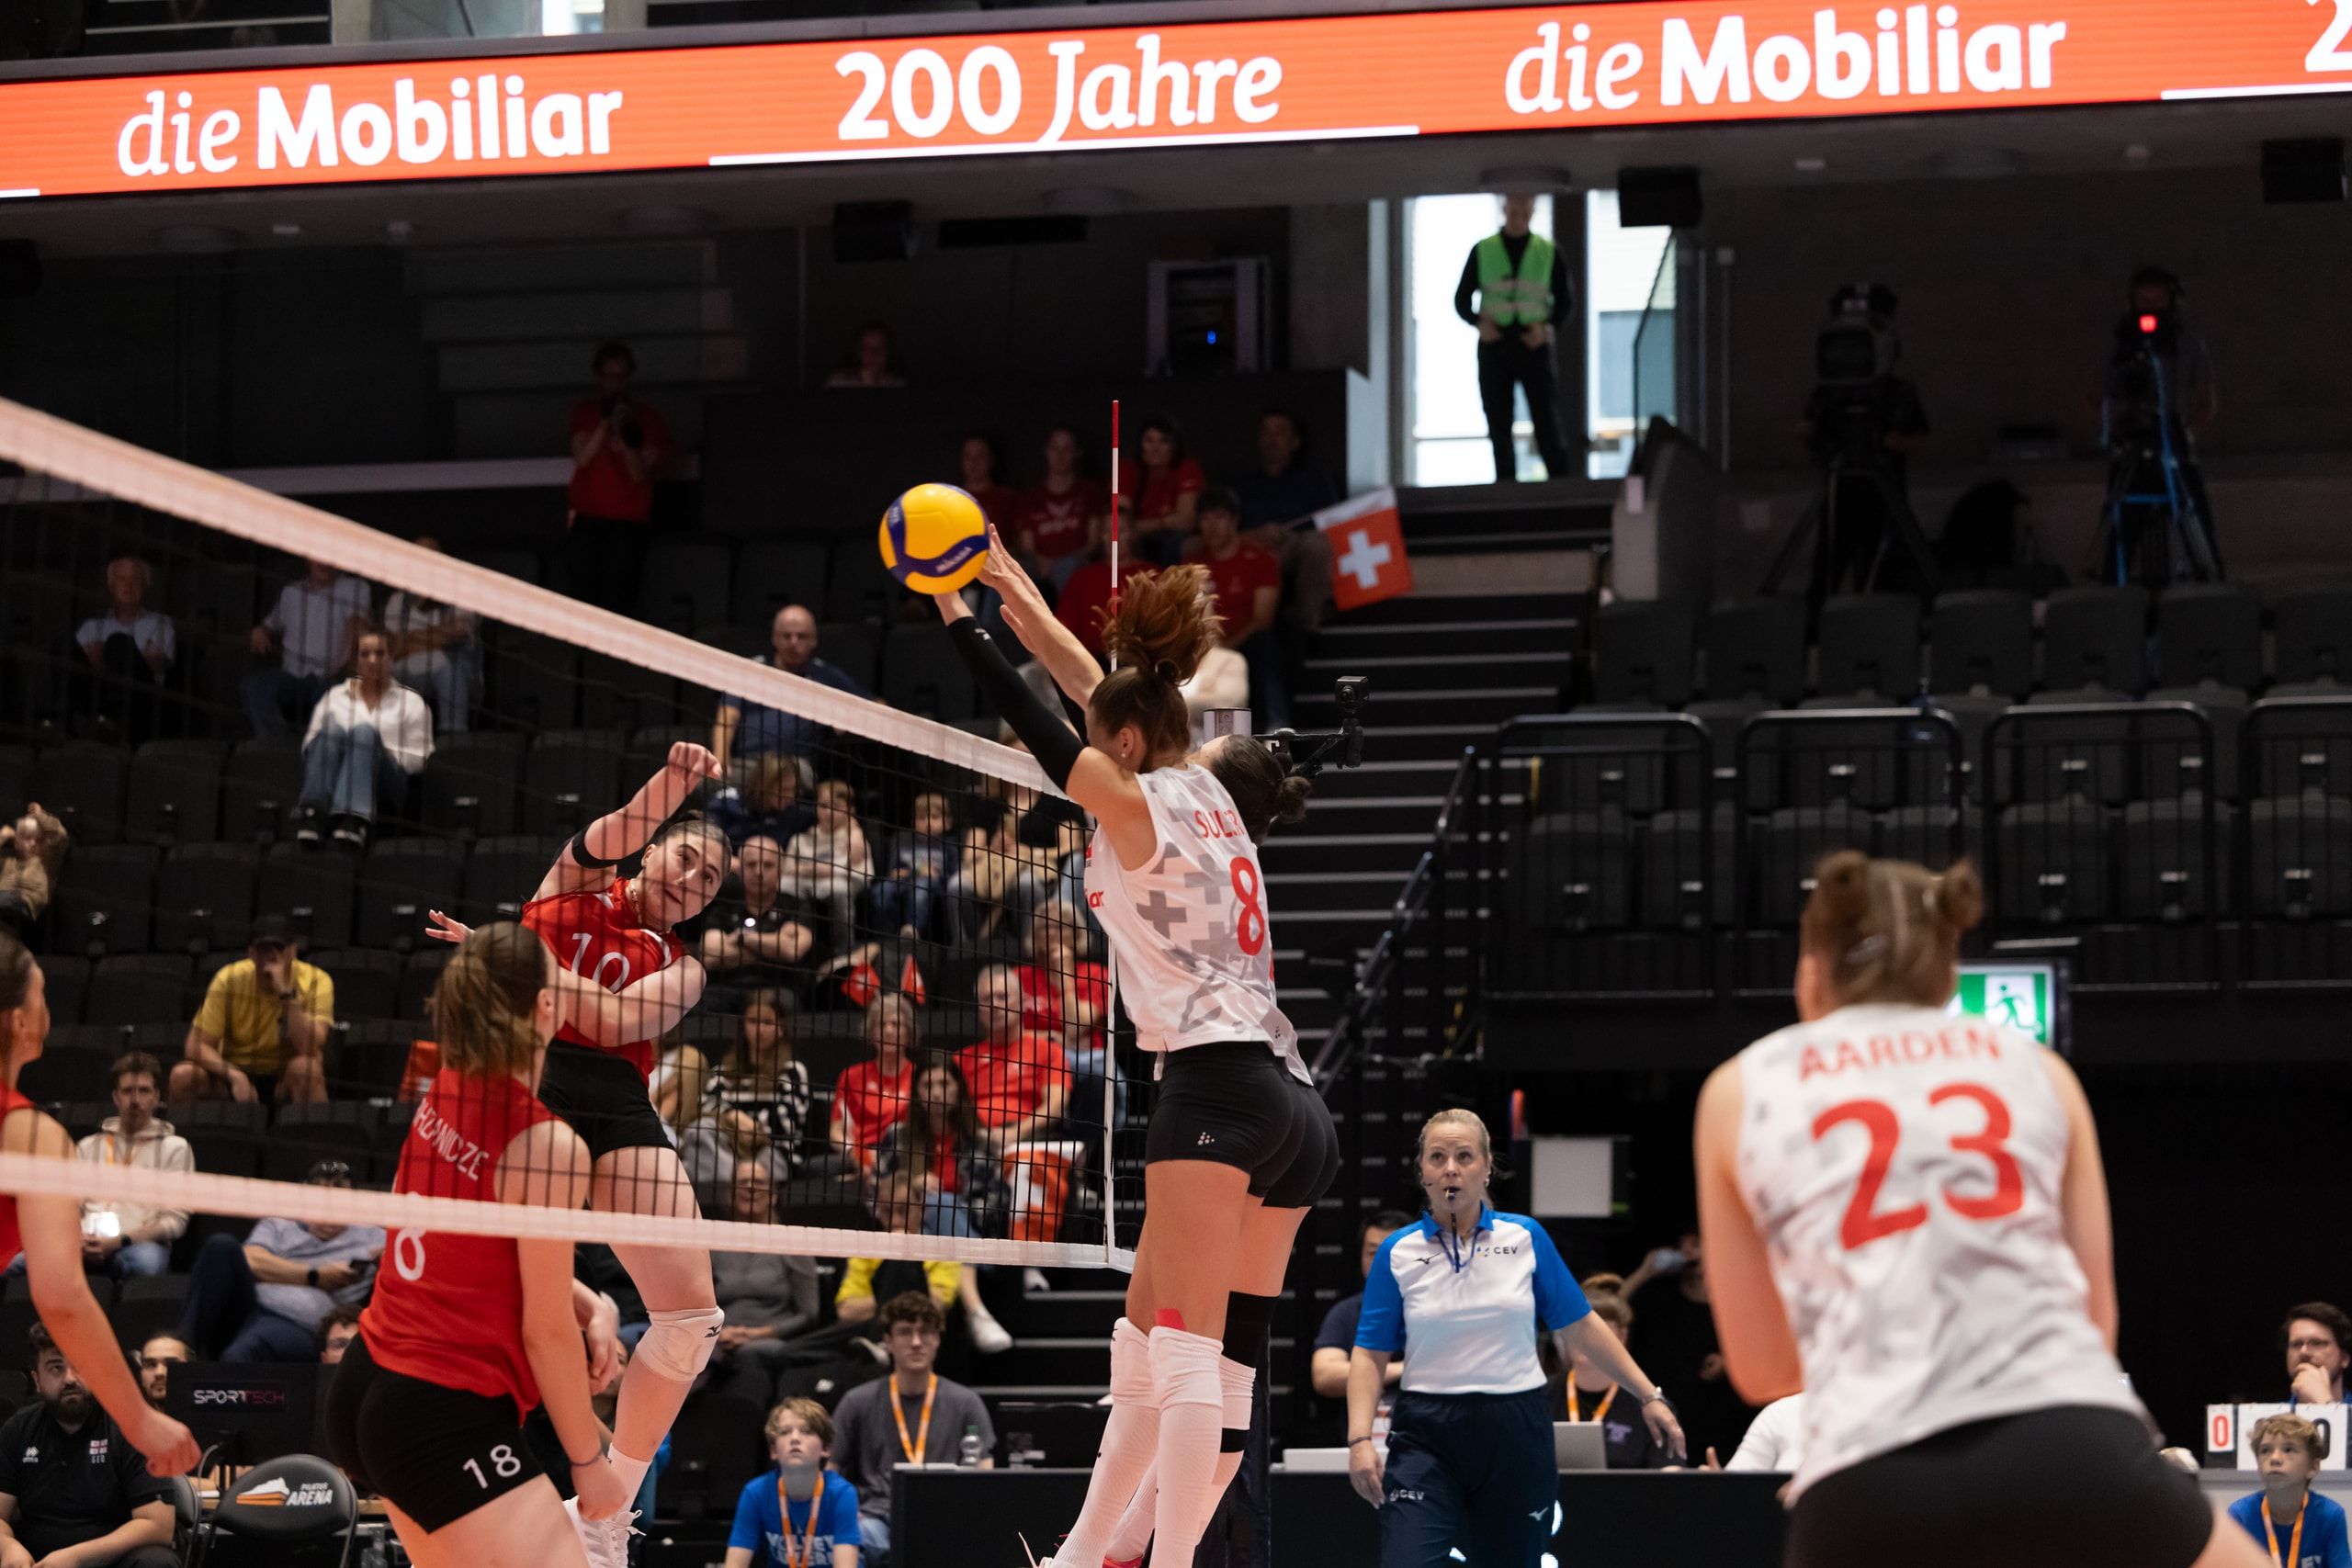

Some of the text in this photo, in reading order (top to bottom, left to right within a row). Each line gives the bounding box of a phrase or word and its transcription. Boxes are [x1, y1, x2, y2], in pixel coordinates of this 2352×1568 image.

[834, 33, 1283, 143] 200 Jahre
[1505, 3, 2068, 115] die Mobiliar
[117, 74, 624, 177] die Mobiliar
[1229, 856, 1265, 956] 8
[571, 932, 630, 994] 10
[1801, 1027, 2001, 1083] AARDEN
[1812, 1081, 2025, 1253] 23
[1494, 1246, 1518, 1255] CEV
[2213, 1416, 2229, 1448] 0
[462, 1444, 522, 1489] 18
[1399, 1489, 1425, 1501] CEV
[286, 1489, 334, 1506] ARENA
